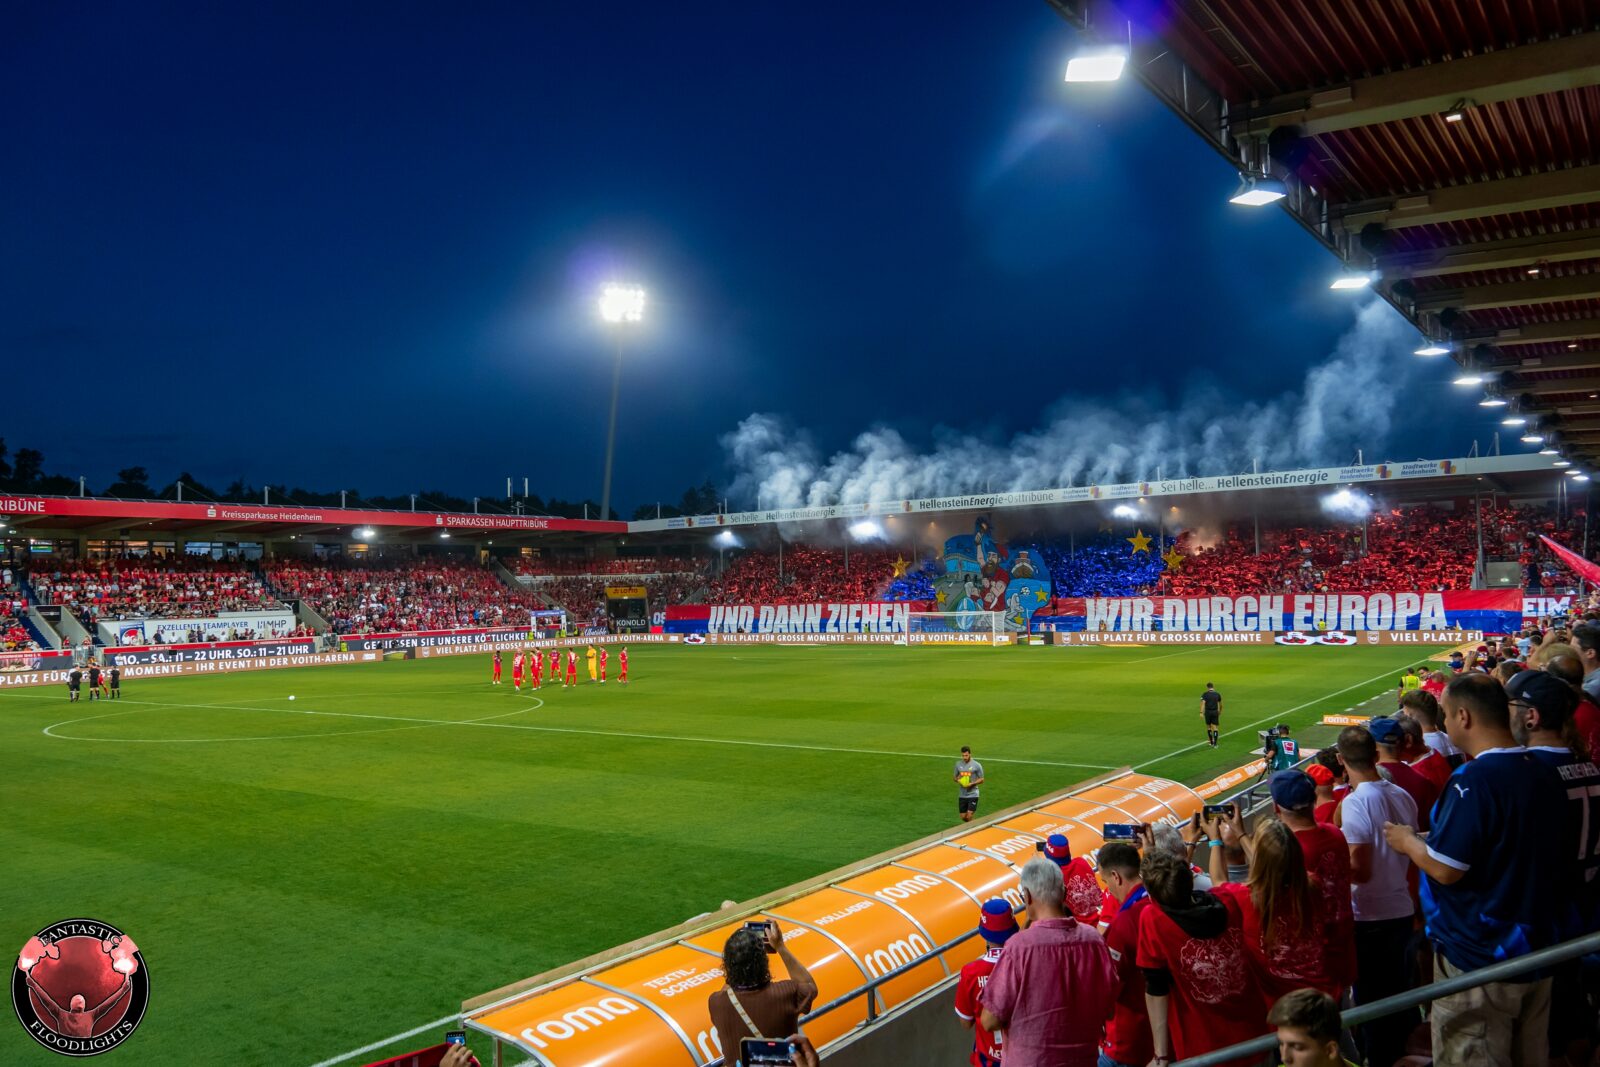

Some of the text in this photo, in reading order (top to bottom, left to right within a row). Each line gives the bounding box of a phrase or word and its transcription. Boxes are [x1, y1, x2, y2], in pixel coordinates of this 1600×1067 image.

[1160, 471, 1328, 492] Sei helle... HellensteinEnergie
[222, 510, 322, 521] Kreissparkasse Heidenheim
[447, 517, 548, 528] SPARKASSEN HAUPTTRIBÜNE
[708, 602, 910, 633] UND DANN ZIEHEN
[1085, 592, 1448, 632] WIR DURCH EUROPA
[364, 632, 546, 650] GEISEN SIE UNSERE KÖTLICHKEIN!
[455, 645, 476, 653] PLATZ
[479, 643, 493, 651] FÜR
[524, 640, 557, 648] MOMENTE
[577, 637, 597, 645] EVENT
[620, 634, 664, 642] VOITH-ARENA
[762, 633, 775, 641] FÜR
[777, 634, 805, 642] GROSSE
[807, 634, 844, 642] MOMENTE
[1080, 632, 1262, 642] VIEL PLATZ FÜR GROSSE MOMENTE
[1390, 632, 1418, 641] VIEL
[1423, 632, 1462, 641] PLATZ
[116, 654, 140, 666] O.
[194, 651, 206, 660] 22
[208, 649, 235, 660] UHR.
[237, 647, 257, 658] SO.:
[259, 647, 266, 656] 11
[276, 646, 285, 655] 21
[288, 645, 309, 655] UHR
[124, 664, 182, 676] MOMENTE
[196, 662, 215, 671] IHR
[219, 660, 252, 670] EVENT
[255, 659, 266, 668] IN
[270, 657, 288, 666] DER
[291, 653, 356, 665] VOITH-ARENA
[0, 674, 38, 686] PLATZ
[43, 670, 70, 682] FÜR
[986, 835, 1037, 857] roma
[874, 874, 942, 903] roma
[864, 933, 931, 978] roma
[643, 967, 696, 988] TEXTIL-
[659, 968, 724, 997] SCREENS
[521, 997, 640, 1048] roma
